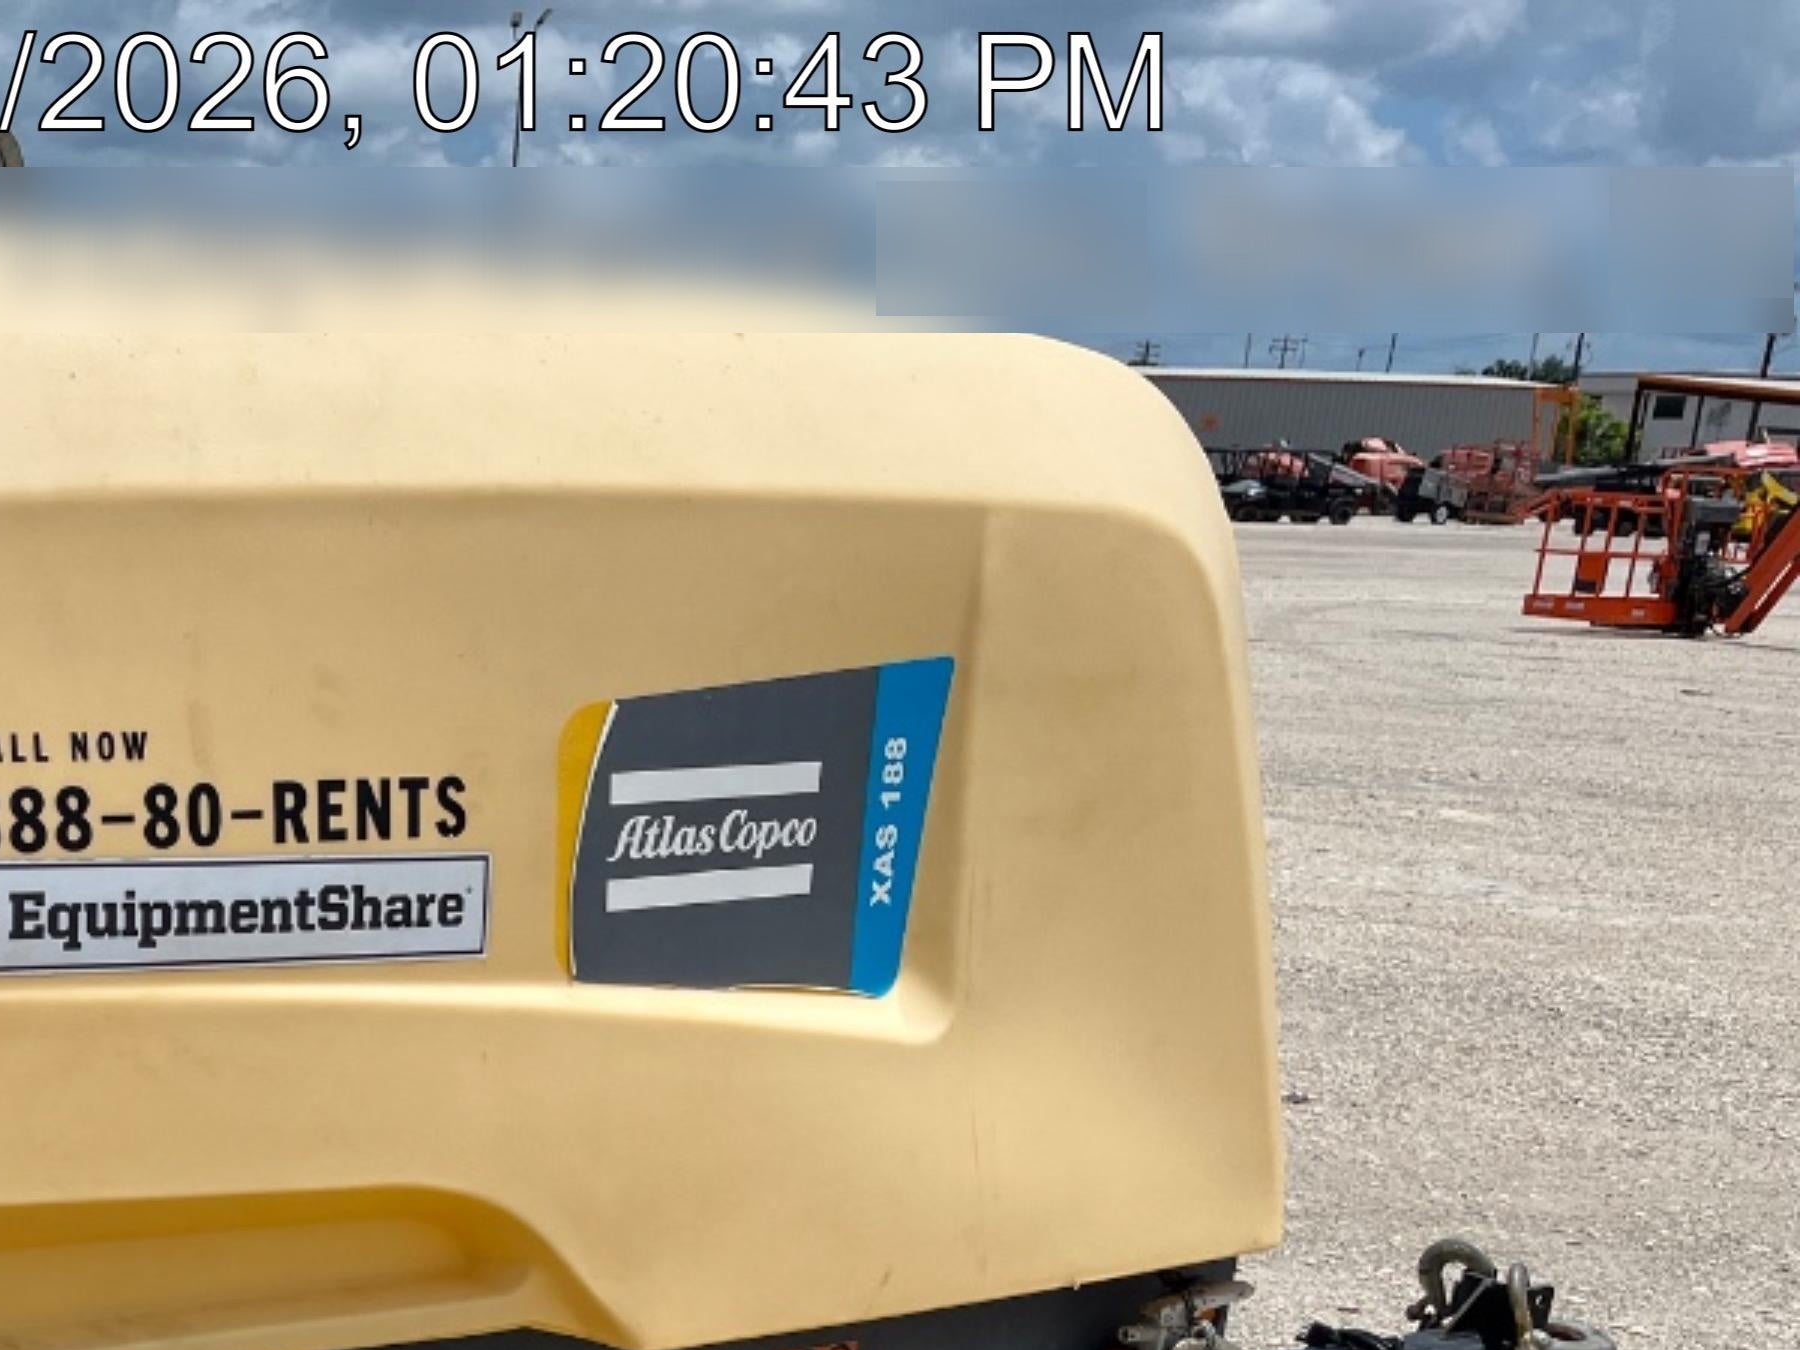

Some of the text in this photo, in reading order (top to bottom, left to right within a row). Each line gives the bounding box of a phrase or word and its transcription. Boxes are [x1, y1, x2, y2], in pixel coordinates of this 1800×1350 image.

[71, 731, 149, 762] NOW
[606, 809, 817, 862] Atlas Copco
[869, 737, 908, 907] XAS 188
[8, 884, 466, 951] EquipmentShare
